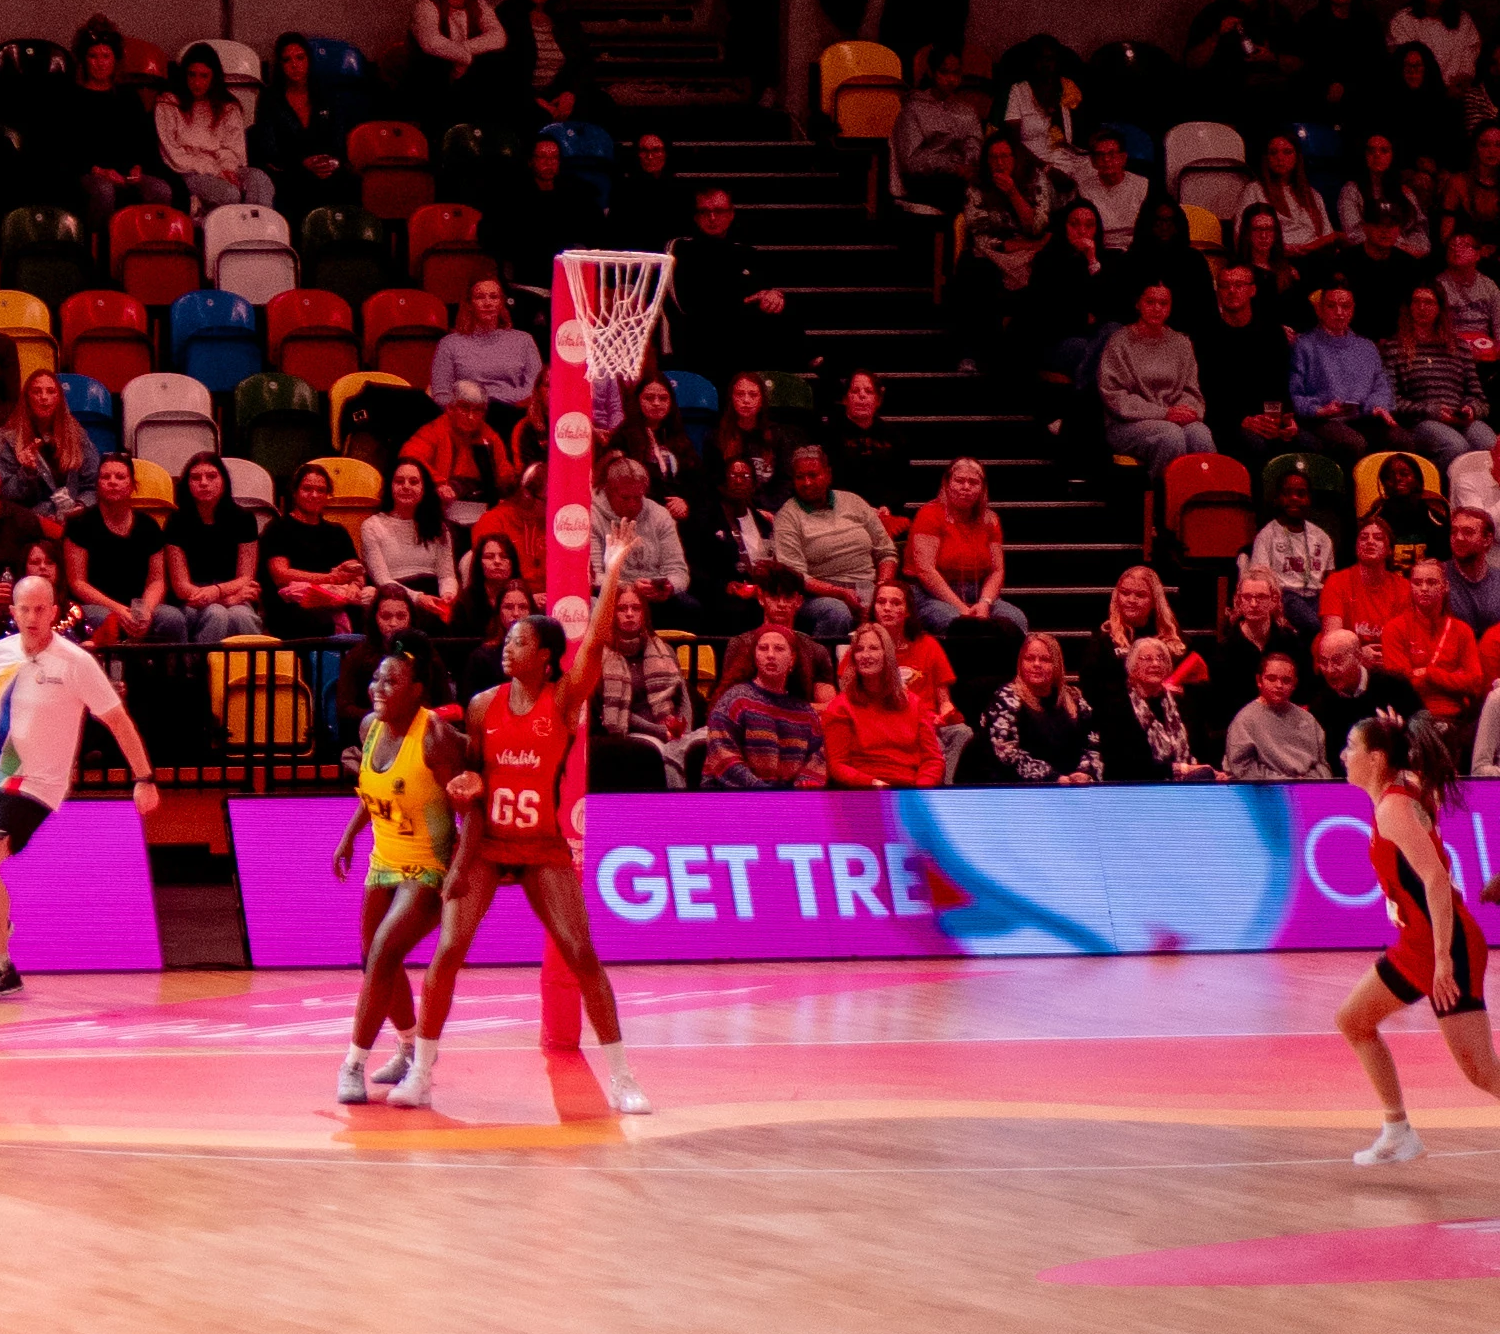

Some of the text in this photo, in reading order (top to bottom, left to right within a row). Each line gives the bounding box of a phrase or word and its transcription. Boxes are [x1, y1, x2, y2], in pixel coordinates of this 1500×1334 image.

[496, 749, 541, 769] Vitality
[492, 787, 541, 829] GS
[596, 843, 760, 921] GET
